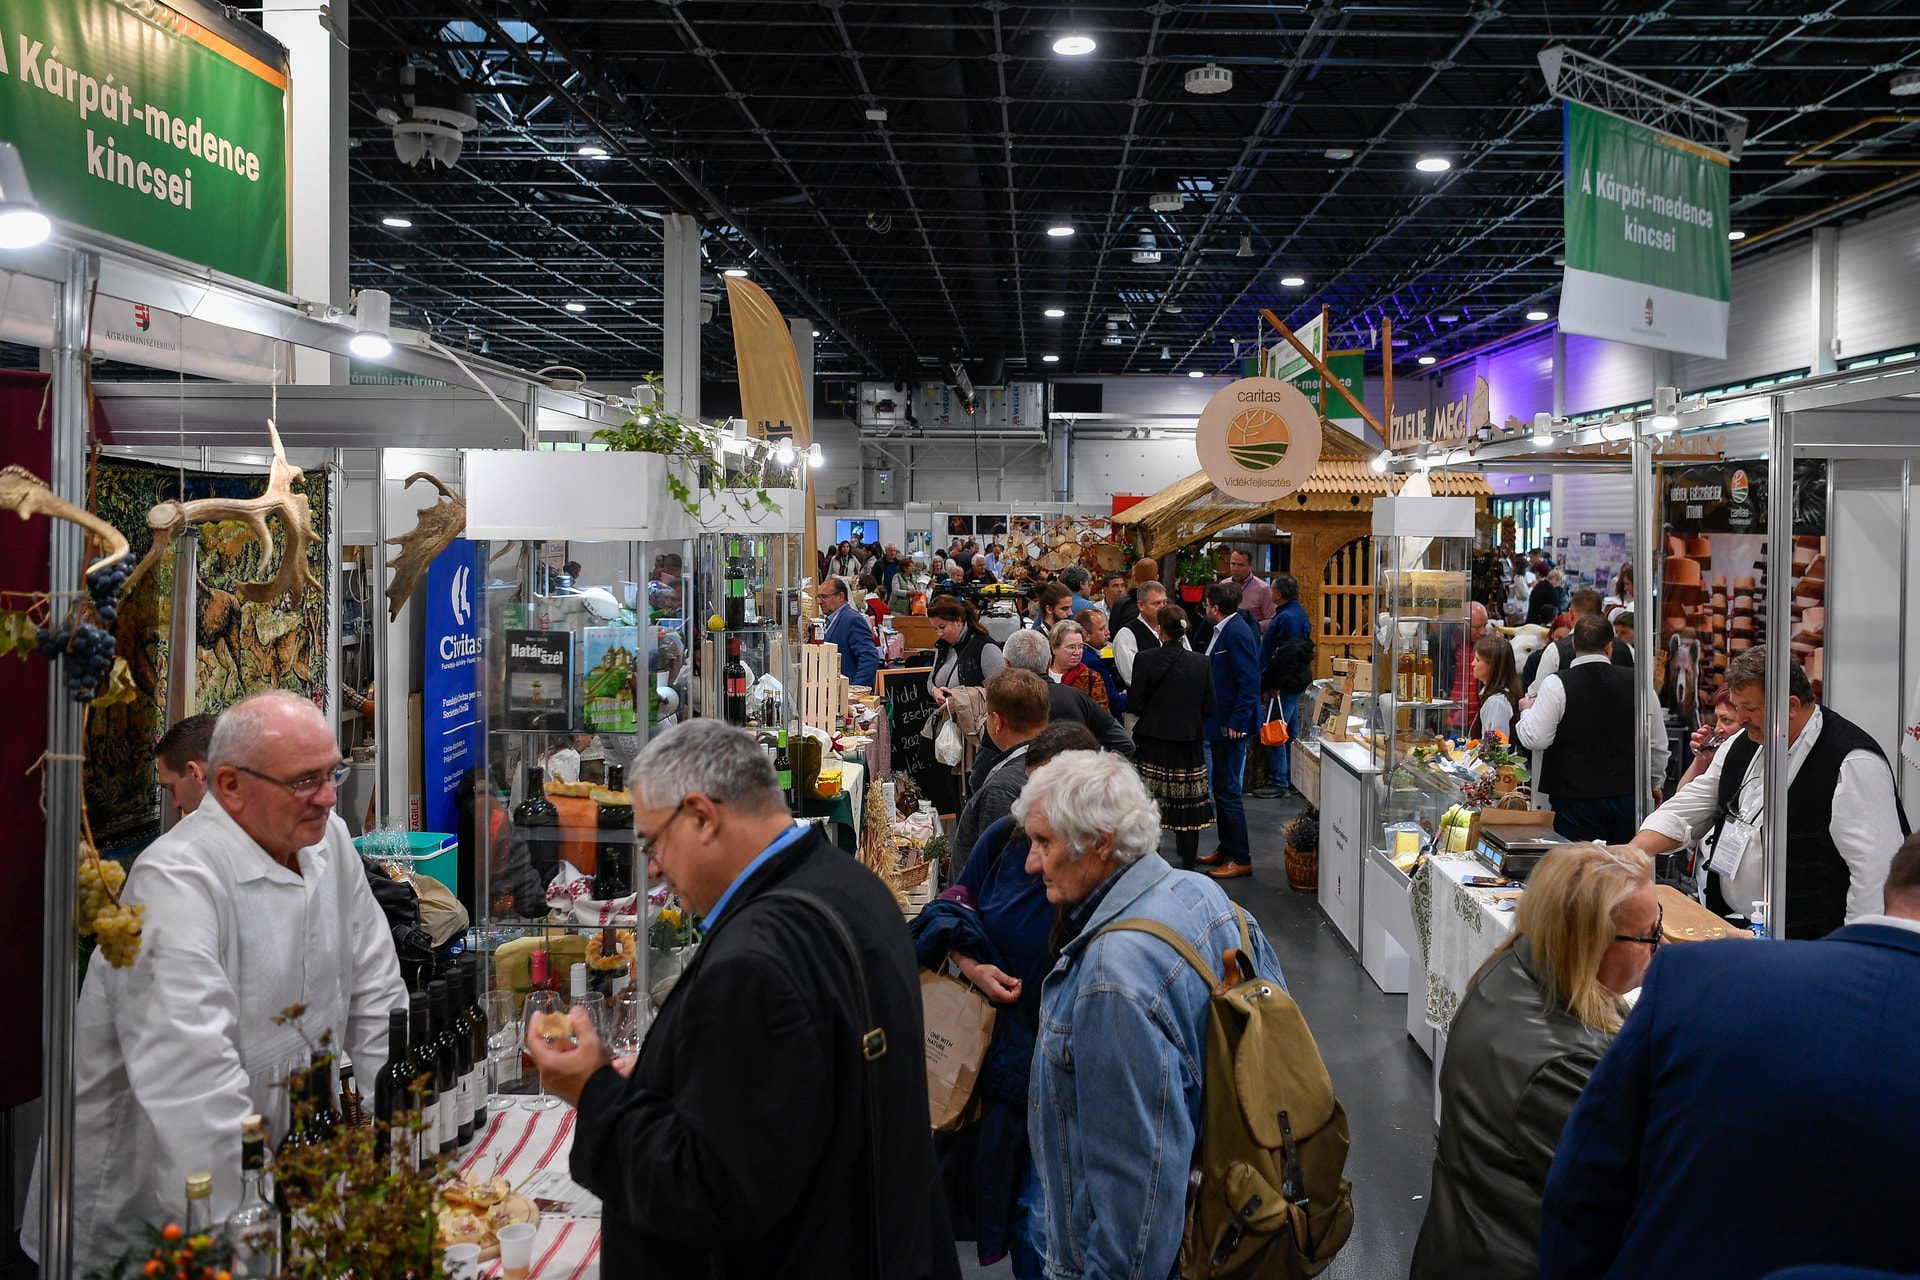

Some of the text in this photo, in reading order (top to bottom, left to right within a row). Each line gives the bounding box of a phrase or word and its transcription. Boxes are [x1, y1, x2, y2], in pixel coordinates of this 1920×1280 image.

[19, 33, 260, 182] Kárpát-medence
[86, 128, 192, 210] kincsei
[1581, 167, 1713, 230] A Kárpát-medence
[1624, 214, 1676, 252] kincsei
[1237, 388, 1281, 403] caritas
[1432, 392, 1469, 442] MEG!
[1224, 477, 1292, 489] Vidékfejlesztés
[440, 633, 482, 660] Civitas
[511, 643, 548, 658] Határ-
[540, 650, 563, 665] szél
[410, 799, 419, 832] RAGILE
[926, 1037, 945, 1051] NATURE
[929, 1031, 953, 1048] ONE WITH
